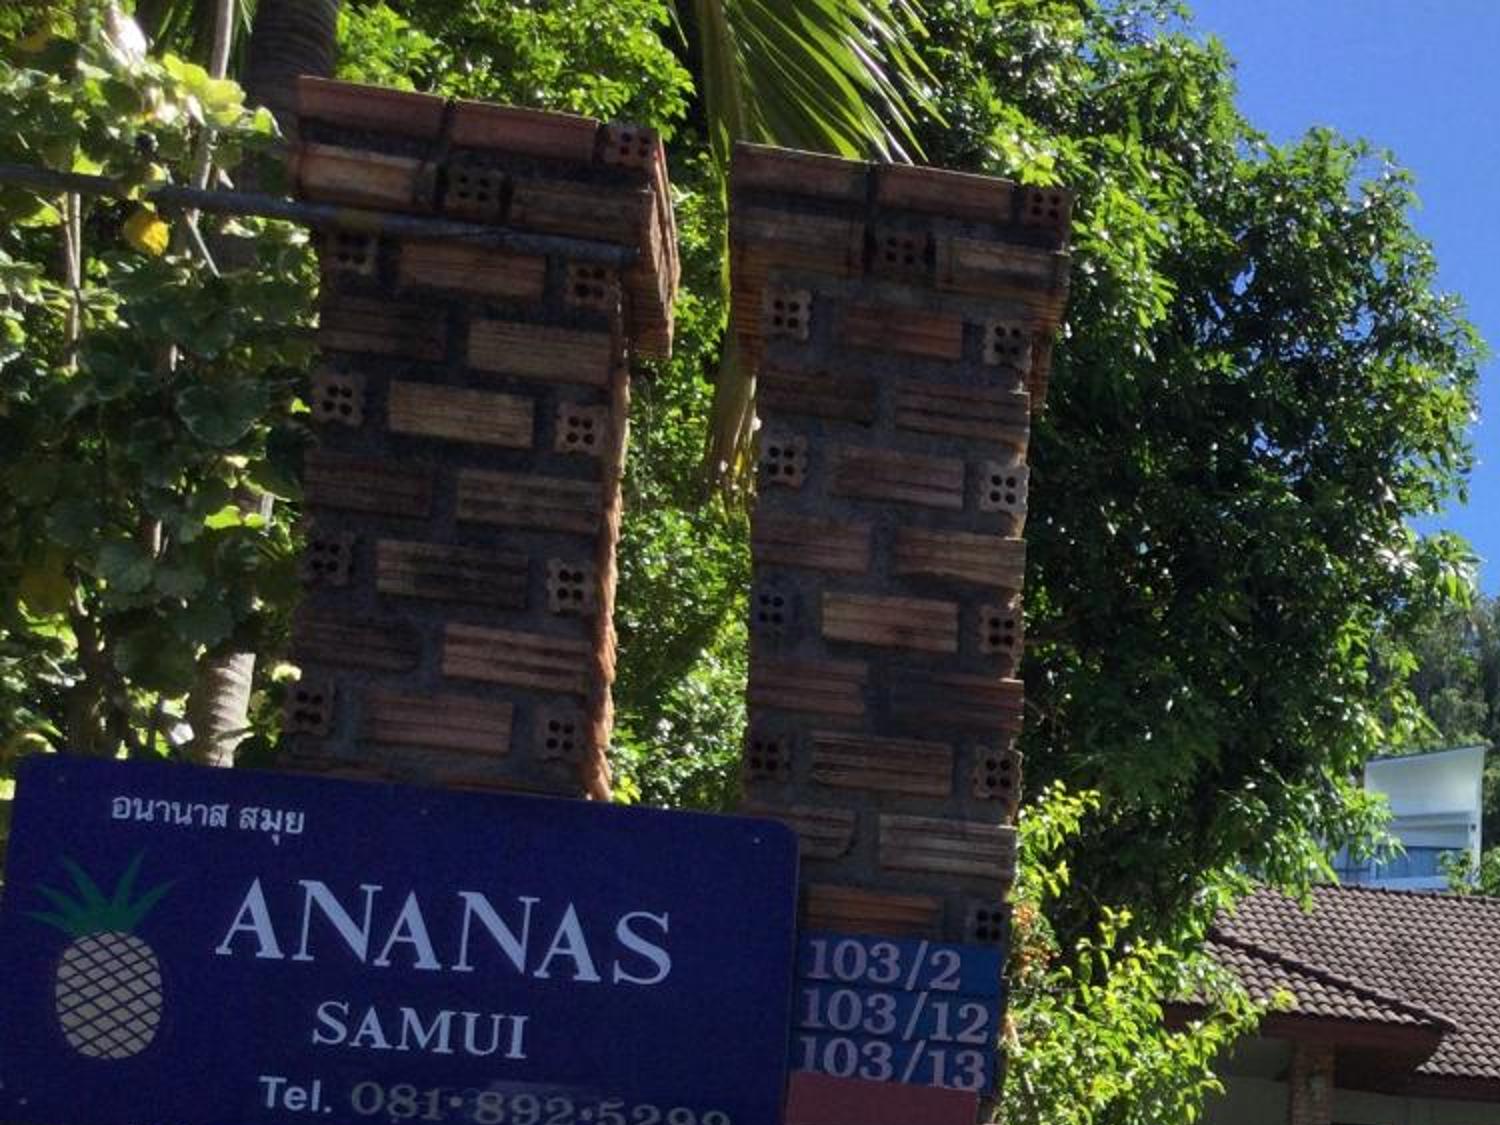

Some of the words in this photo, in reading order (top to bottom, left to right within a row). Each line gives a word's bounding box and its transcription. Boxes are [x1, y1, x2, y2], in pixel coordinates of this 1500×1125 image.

[112, 796, 229, 827] อนานาส
[239, 807, 304, 846] สมุย
[215, 876, 672, 985] ANANAS
[808, 939, 961, 991] 103/2
[311, 1001, 528, 1059] SAMUI
[803, 989, 990, 1044] 103/12
[801, 1036, 986, 1090] 103/13
[259, 1075, 332, 1113] Tel.
